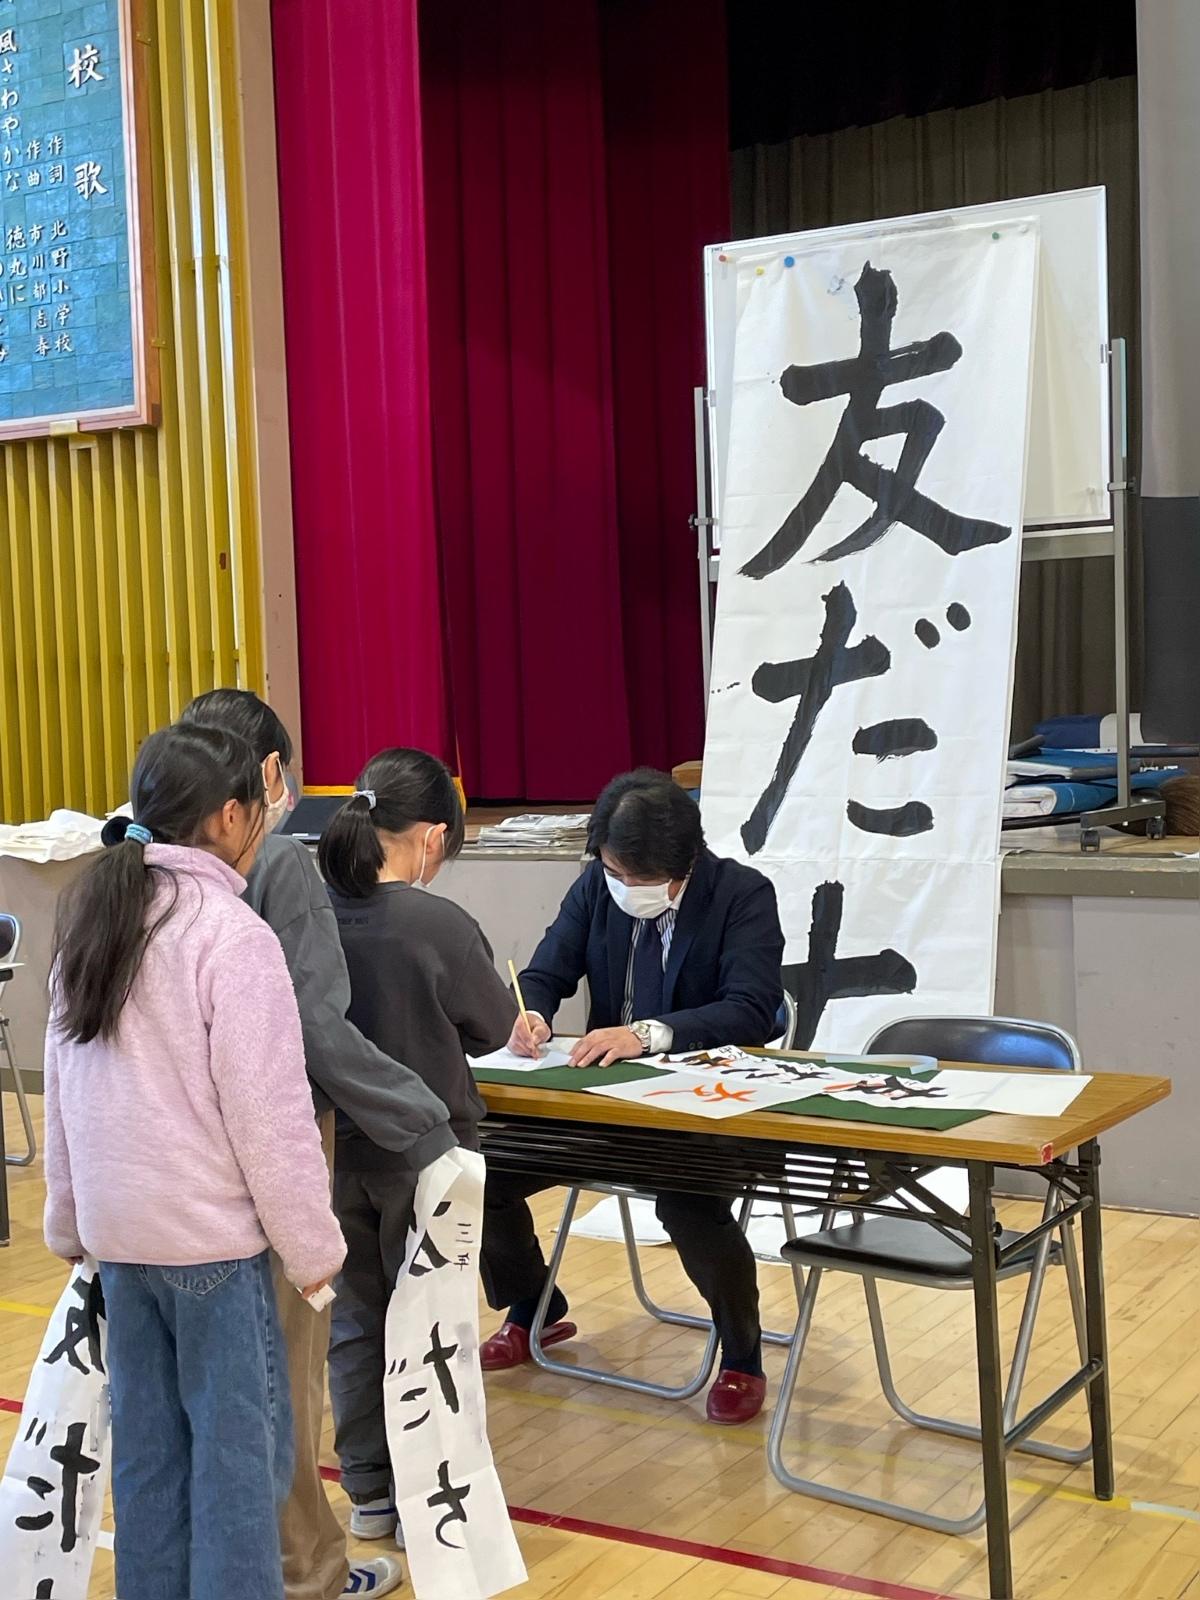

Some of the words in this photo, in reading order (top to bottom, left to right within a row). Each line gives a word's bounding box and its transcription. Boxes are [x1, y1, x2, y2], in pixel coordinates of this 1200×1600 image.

[0, 28, 21, 192] 風さわやかな
[26, 140, 42, 187] 作曲
[48, 135, 65, 184] 作詞
[67, 43, 108, 201] 校歌
[5, 224, 27, 304] 徳丸に
[51, 219, 73, 353] 北野小学校
